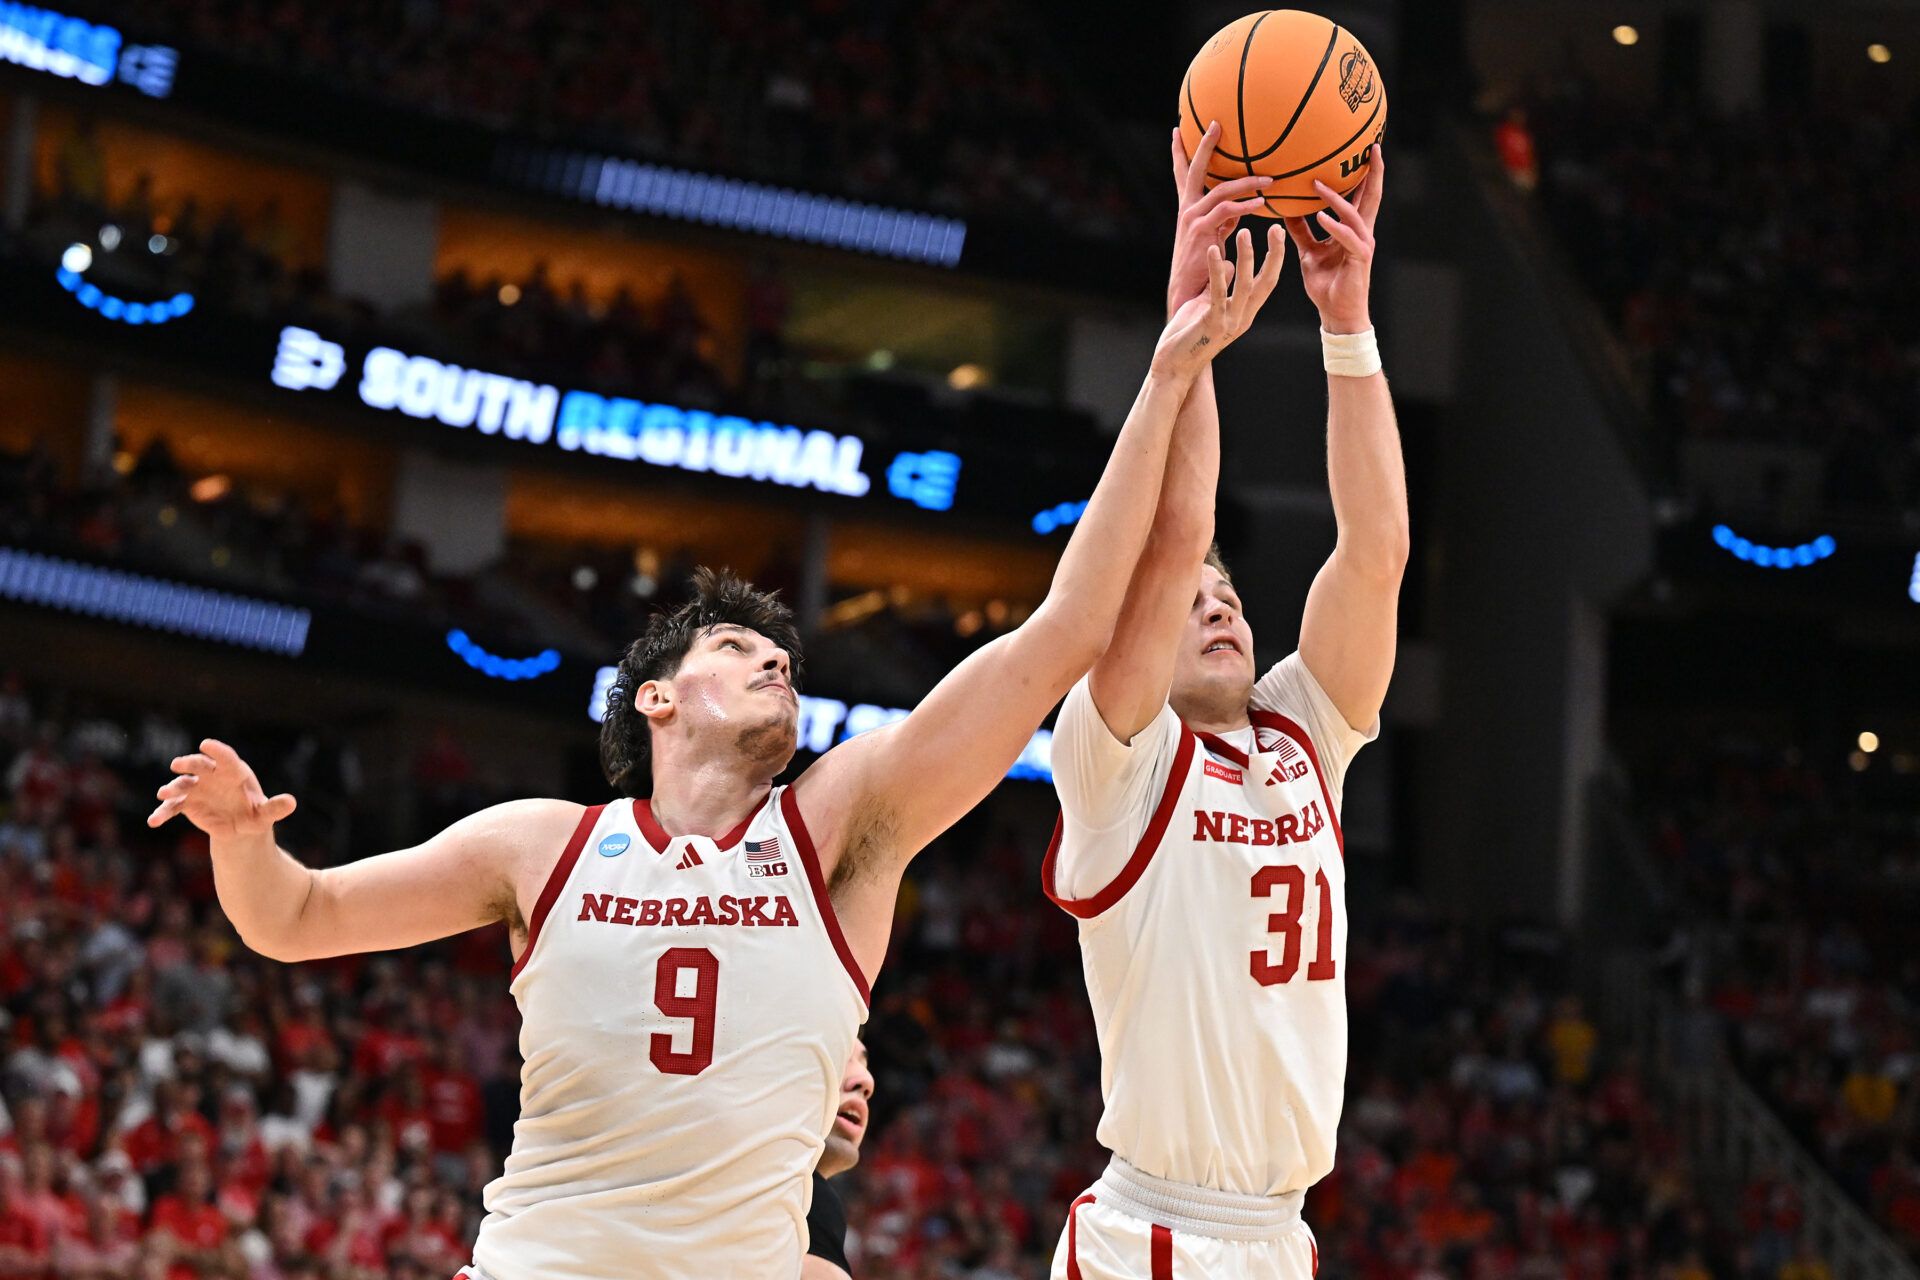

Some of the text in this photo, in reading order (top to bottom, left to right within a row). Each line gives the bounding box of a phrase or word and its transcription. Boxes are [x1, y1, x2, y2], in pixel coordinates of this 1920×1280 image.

[359, 346, 871, 498] SOUTH REGIONAL
[1205, 763, 1242, 782] GRADUATE
[577, 893, 799, 928] NEBRASKA
[1249, 864, 1336, 988] 31
[649, 946, 720, 1076] 9
